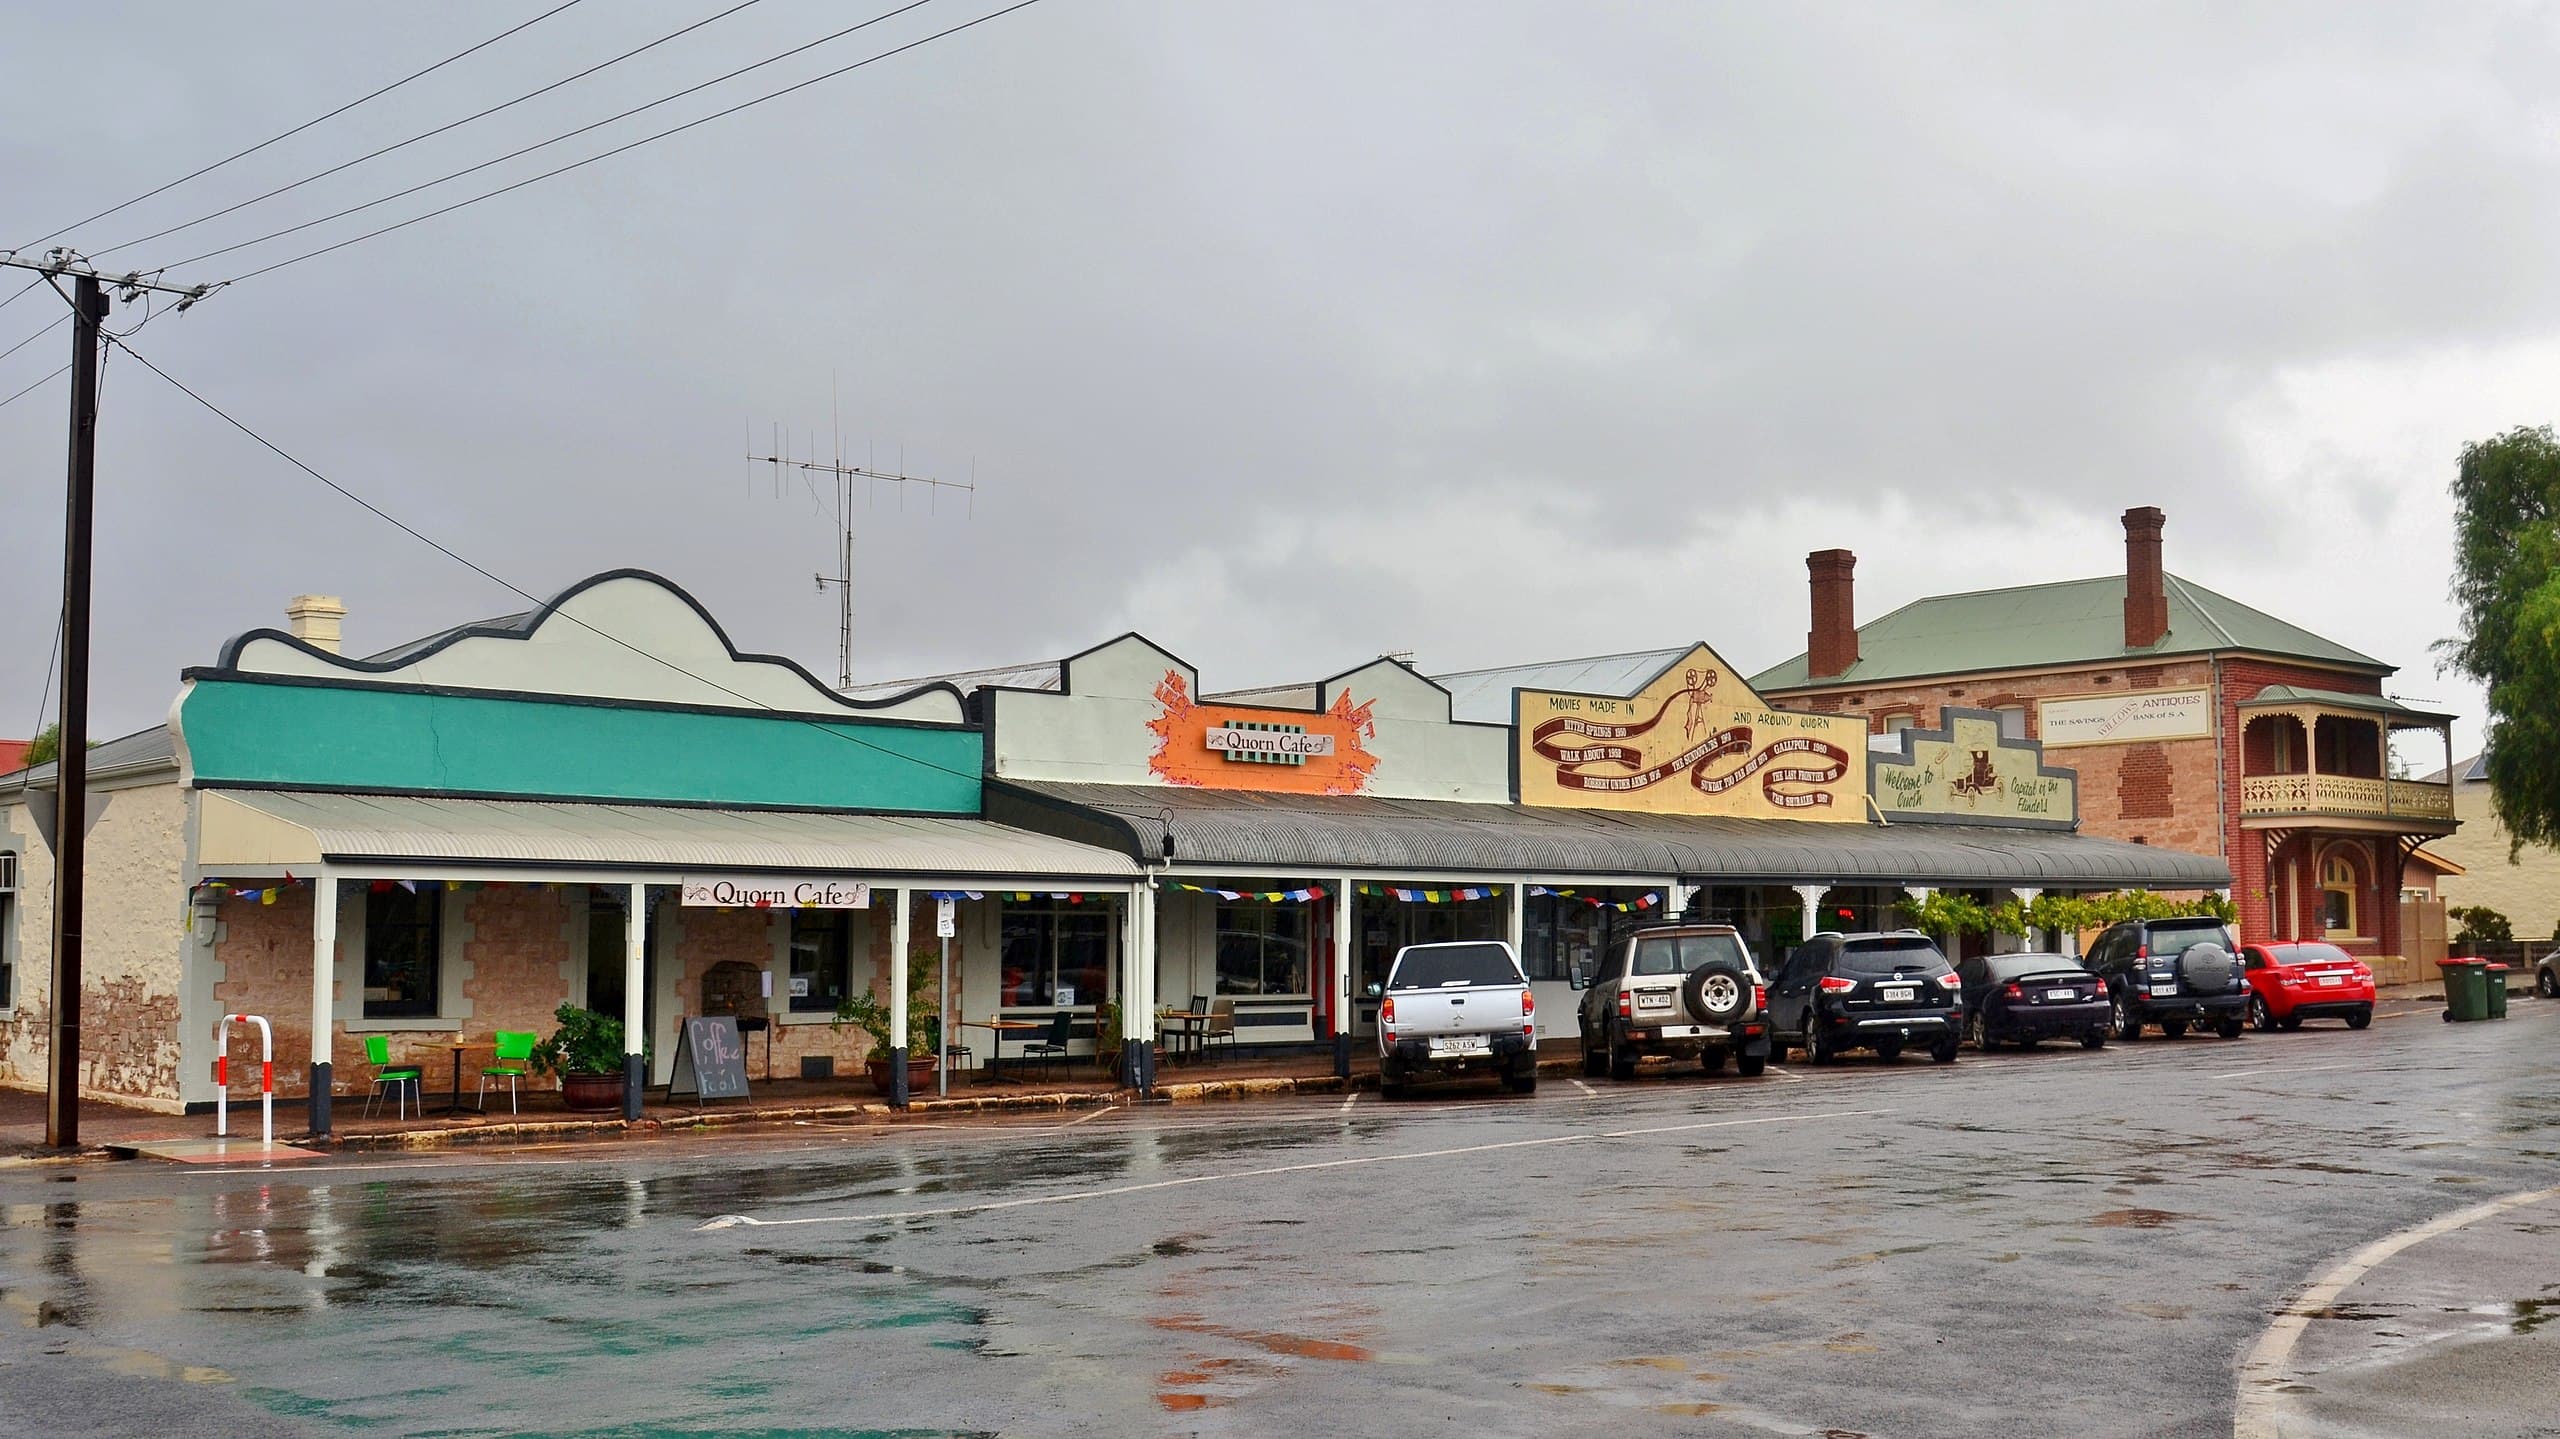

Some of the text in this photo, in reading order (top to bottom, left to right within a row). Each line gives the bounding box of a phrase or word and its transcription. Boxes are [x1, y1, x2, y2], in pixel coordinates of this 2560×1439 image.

[1550, 698, 1634, 715] MOVIES MADE IN
[2142, 695, 2200, 708] ANTIQUES
[1734, 712, 1829, 729] AND AROUND QUORN
[2098, 702, 2138, 736] WILLOWS
[2133, 713, 2154, 721] BANK
[1564, 719, 1585, 733] BITTER
[1586, 725, 1612, 737] SPRINGS
[1226, 731, 1312, 753] Quorn Cafe
[1774, 740, 1828, 754] GALLIPOLI 1980
[1560, 750, 1580, 761] WALK
[1583, 748, 1605, 760] ABOUT
[1672, 758, 1685, 771] THE
[1611, 778, 1631, 789] UNDER
[1631, 774, 1647, 788] ARMS
[1700, 779, 1723, 792] SUNDAY
[1723, 775, 1735, 788] TOO
[1734, 767, 1746, 782] FAR
[1745, 759, 1758, 775] AWAY
[1772, 770, 1784, 782] THE
[1784, 770, 1796, 780] LAST
[1798, 770, 1825, 782] FRONTIER
[1885, 764, 1933, 790] Welcome to
[2011, 776, 2058, 797] Capital of the
[1772, 792, 1784, 805] THE
[1897, 790, 1922, 808] Quorn
[2017, 797, 2048, 813] Flinders
[713, 881, 842, 905] Quorn Cafe
[690, 1020, 740, 1065] Coffee
